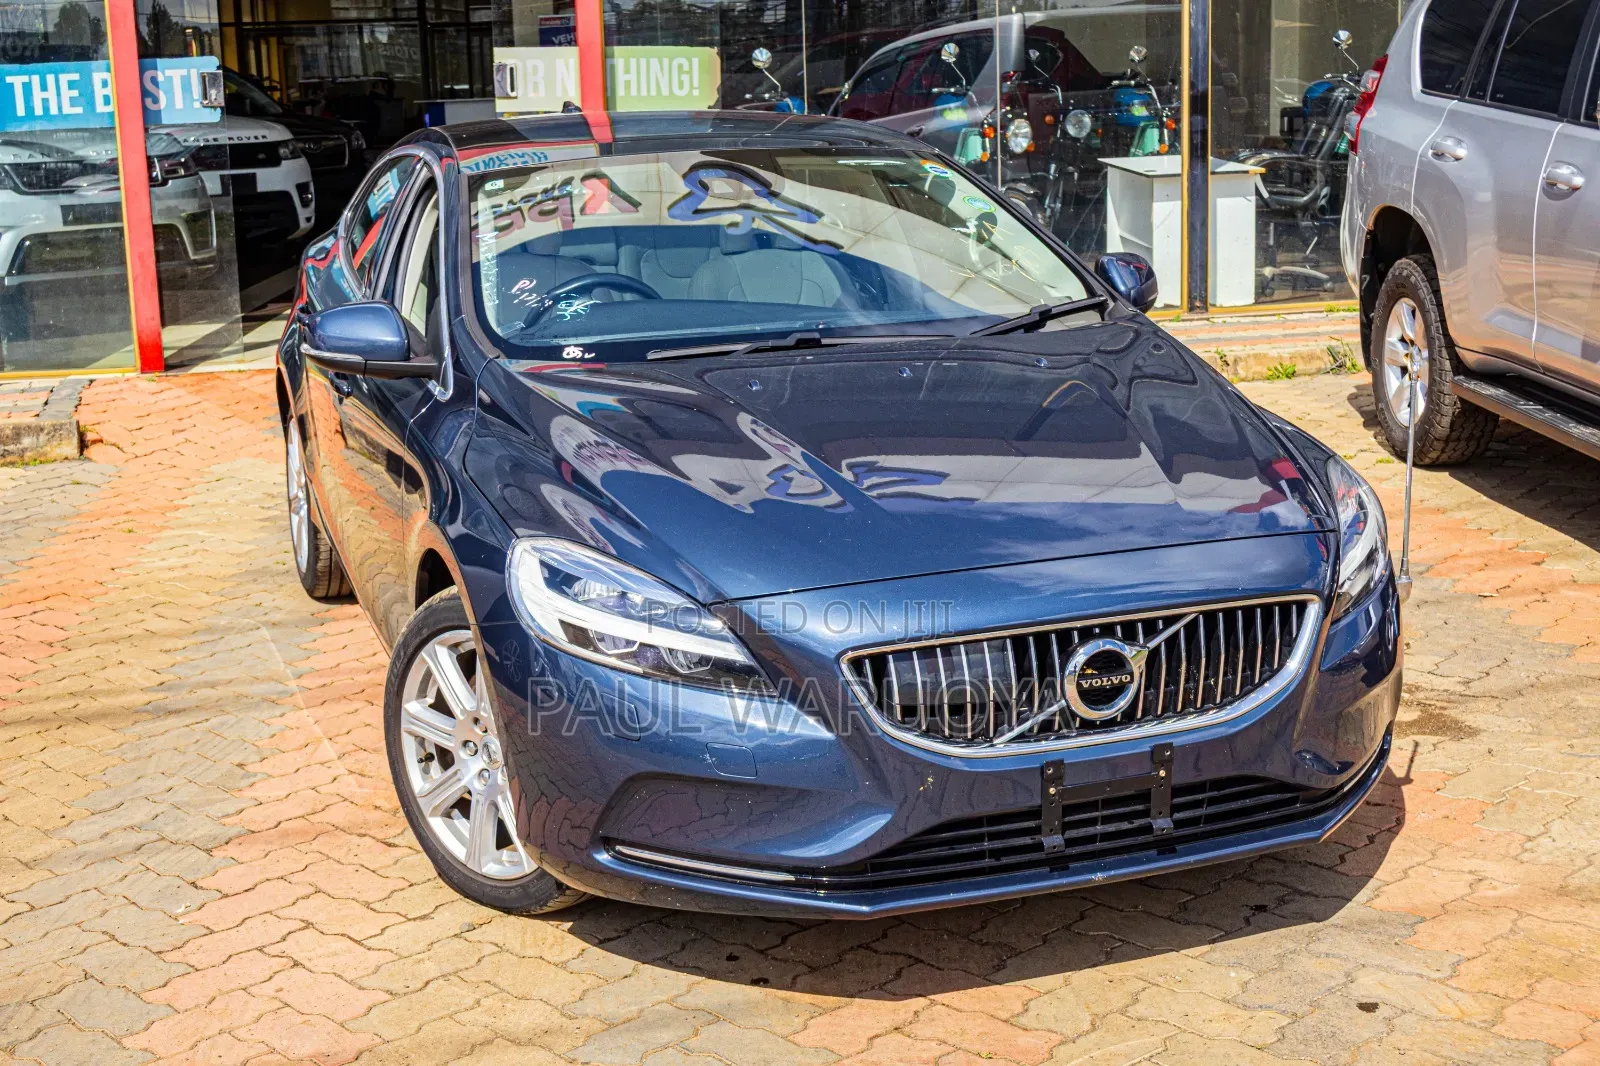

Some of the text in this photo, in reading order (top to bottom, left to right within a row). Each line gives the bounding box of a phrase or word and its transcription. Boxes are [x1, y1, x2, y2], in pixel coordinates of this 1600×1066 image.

[555, 57, 700, 97] NTHING!
[5, 68, 201, 117] THE BST!
[227, 135, 269, 143] ROVER
[1079, 674, 1132, 689] VOLVO
